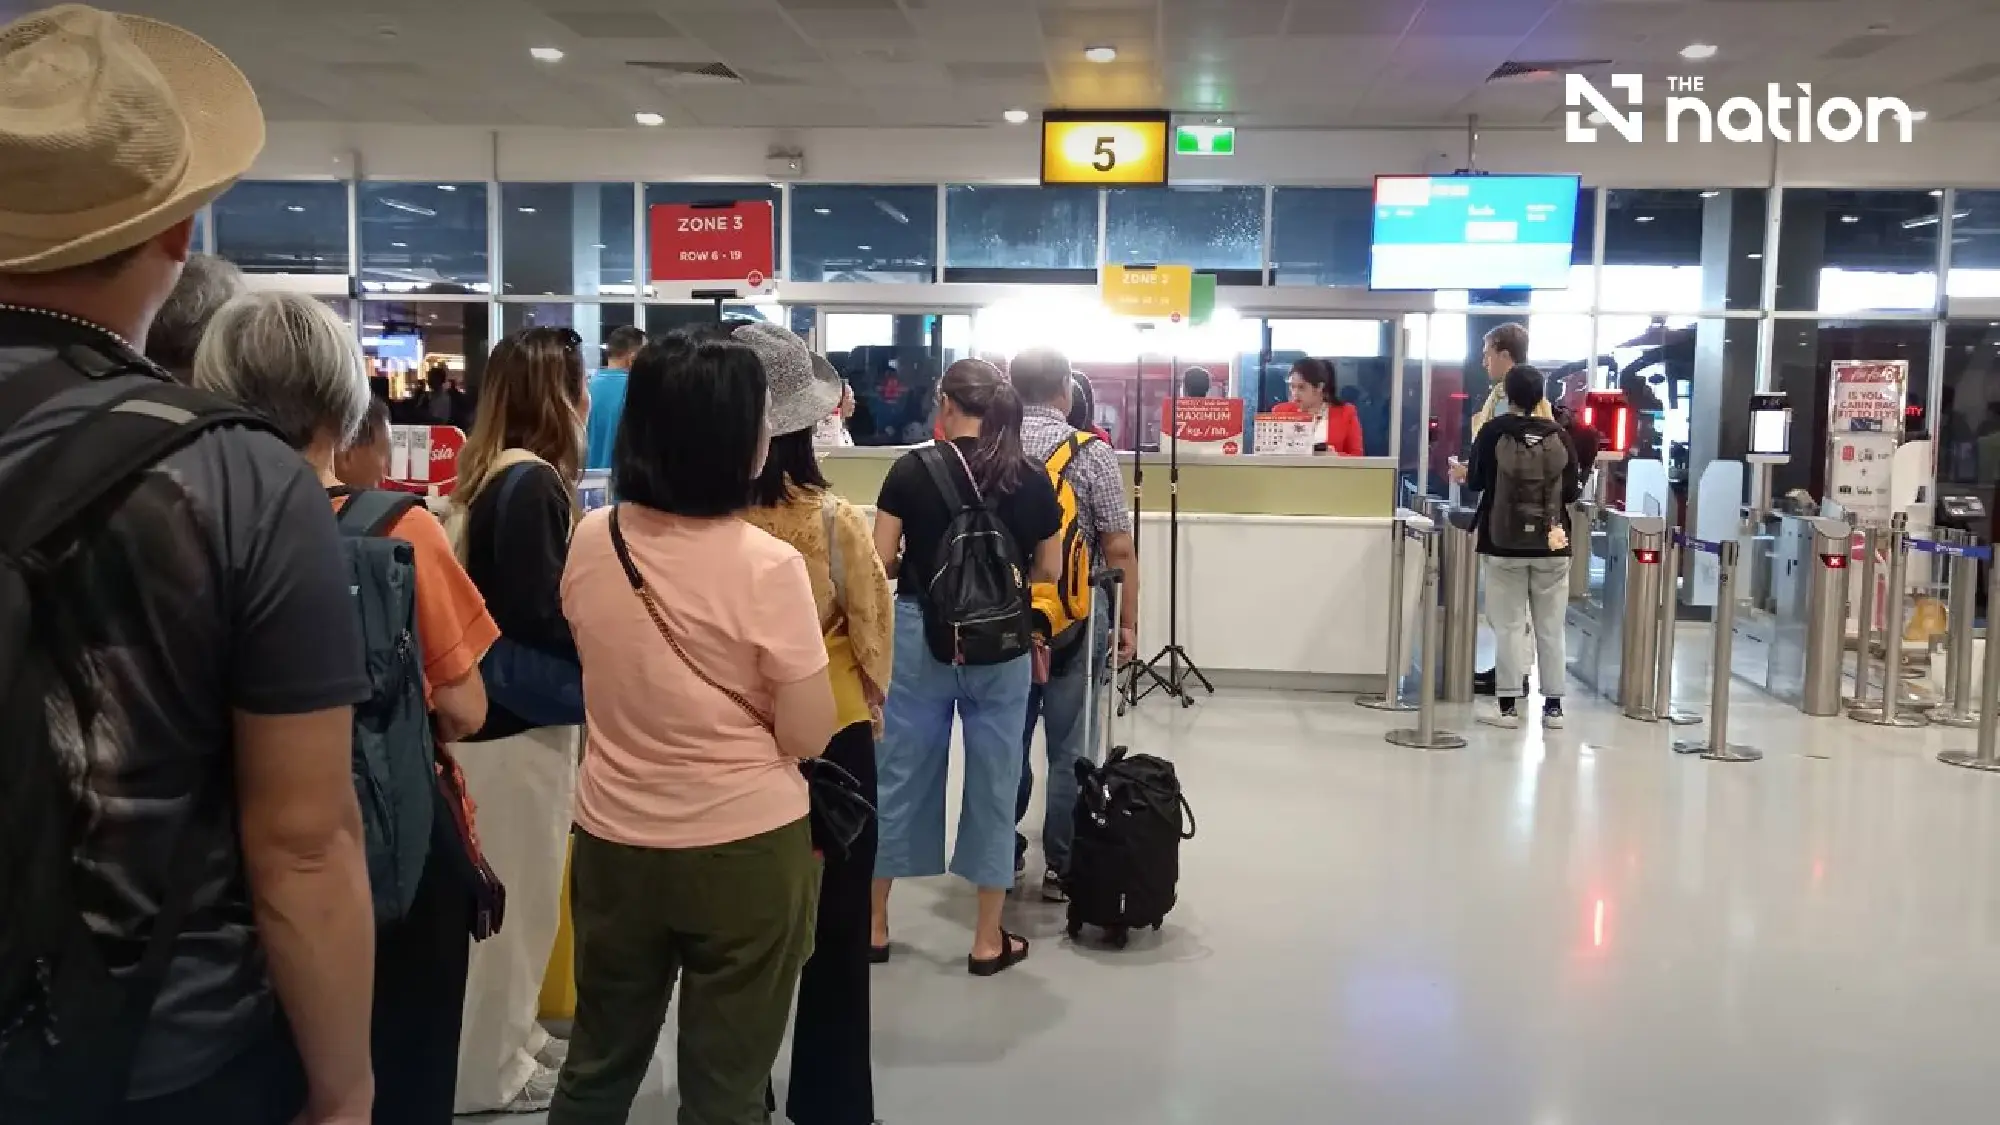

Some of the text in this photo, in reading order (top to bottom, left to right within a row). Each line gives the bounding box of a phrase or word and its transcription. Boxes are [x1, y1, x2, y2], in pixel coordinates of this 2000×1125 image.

[1091, 136, 1116, 172] 5
[677, 215, 743, 232] ZONE 3
[679, 251, 709, 261] ROW
[711, 250, 719, 261] 6
[729, 250, 743, 261] 19
[1122, 273, 1158, 284] ZONE
[1860, 391, 1888, 400] YOU
[1176, 411, 1232, 421] MAXIMUM
[1176, 421, 1187, 437] 7
